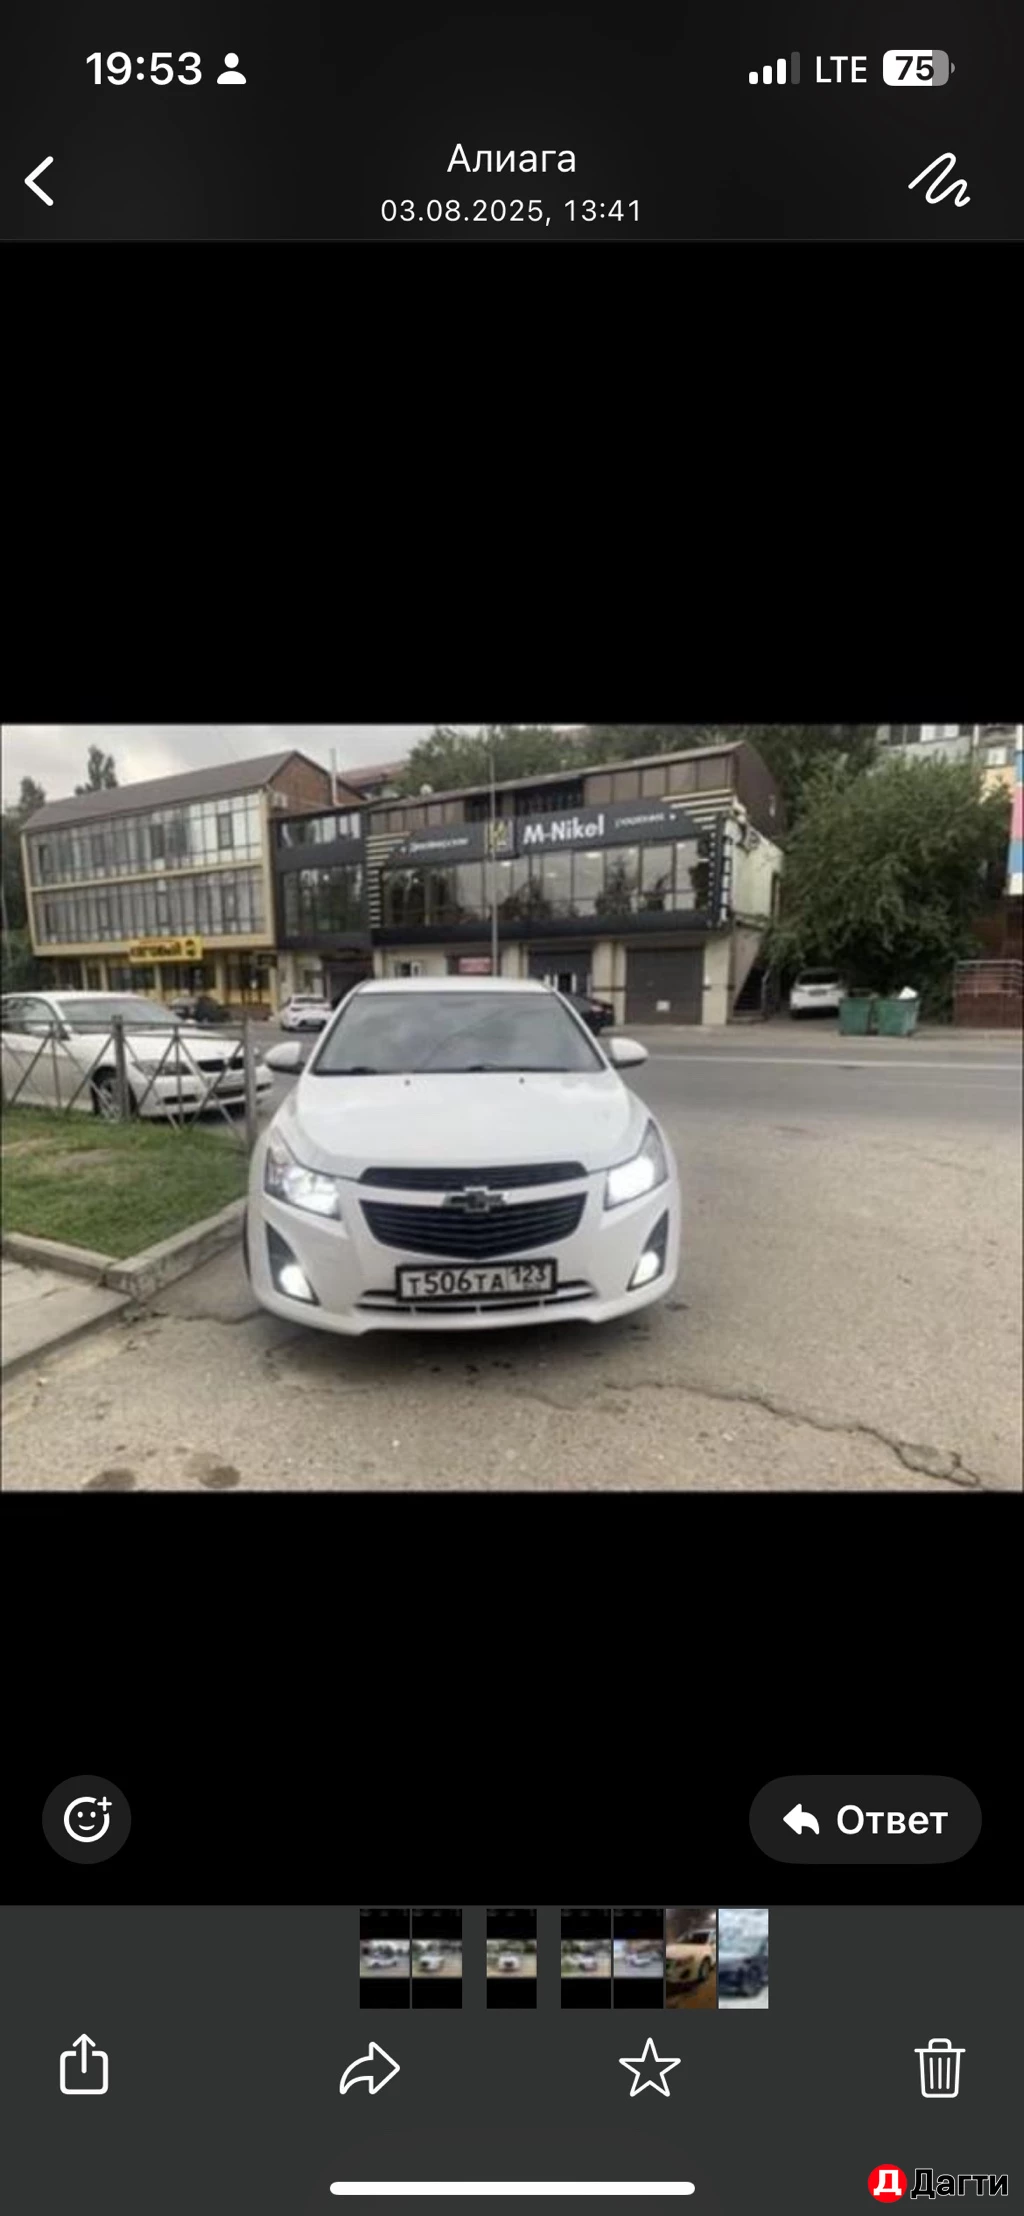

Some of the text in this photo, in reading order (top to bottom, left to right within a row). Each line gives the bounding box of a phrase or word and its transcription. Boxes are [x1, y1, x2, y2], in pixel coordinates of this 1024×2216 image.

[86, 51, 202, 86] 19:53
[816, 55, 867, 83] LTE
[895, 55, 935, 81] 75
[446, 143, 576, 173] Алиага
[381, 199, 639, 227] 03.08.2025, 13:41
[523, 813, 605, 845] M-Nikel
[836, 1804, 949, 1835] Ответ
